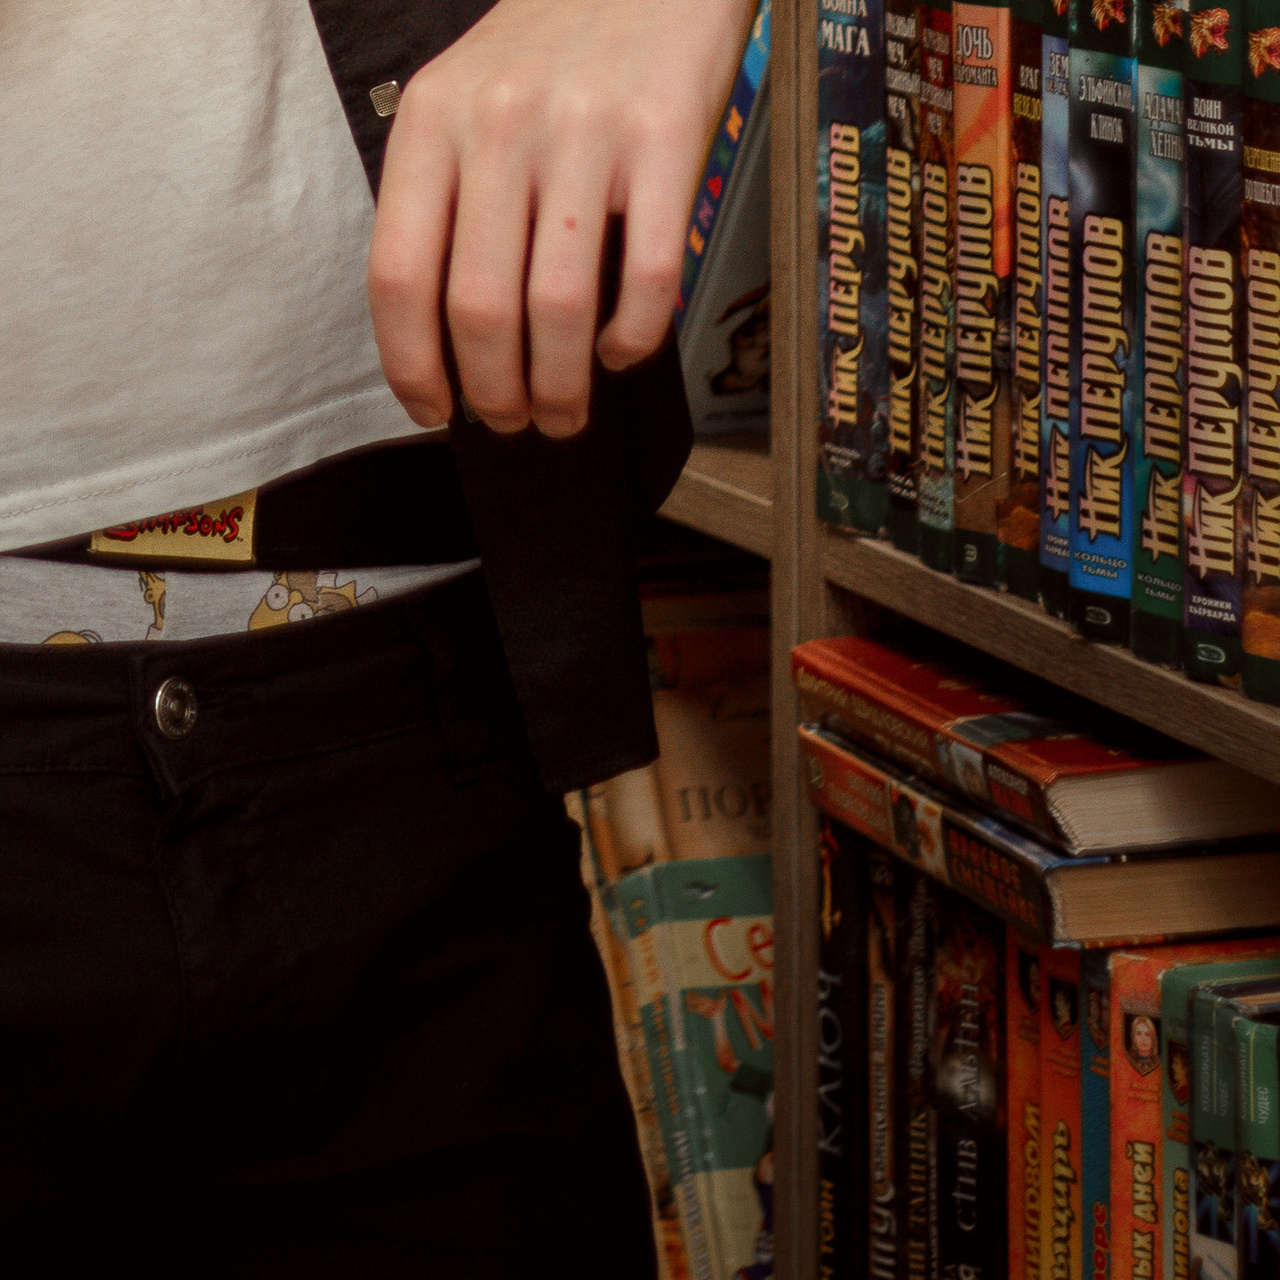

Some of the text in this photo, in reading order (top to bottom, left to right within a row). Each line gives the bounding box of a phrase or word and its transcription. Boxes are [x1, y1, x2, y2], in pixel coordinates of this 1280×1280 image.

[821, 19, 871, 57] МАГА
[1049, 52, 1069, 79] ЗЕМ
[1079, 75, 1132, 111] ЭЛЬФИЙСКИЙ
[1143, 92, 1183, 125] АДАМА
[1194, 97, 1221, 120] ВОИН
[1091, 113, 1123, 143] КЛИНОК
[1187, 118, 1234, 136] ВЕЛИКОЙ
[1188, 134, 1234, 151] ТЬМЫ
[829, 122, 865, 337] ПЕРУМОВ
[922, 162, 952, 382] ПЕРУМОВ
[1016, 162, 1042, 387] ПЕРУМОВ
[956, 162, 999, 481] НИК ПЕРУМОВ
[829, 336, 864, 429] НИК
[1079, 214, 1131, 543] НИК ПЕРУМОВ
[1248, 248, 1280, 482] ПЕРУМОВ
[1142, 231, 1183, 564] НИК ПЕРУМОВ
[1187, 245, 1243, 580] НИК ПЕРУМОВ
[1074, 551, 1127, 569] КОЛЬЦО
[1082, 565, 1117, 579] ТЬМЫ
[1136, 573, 1182, 592] КОЛЬЦО
[1145, 588, 1175, 602] ТЬМЫ
[1191, 595, 1232, 610] ХРОНИКИ
[949, 828, 1019, 890] КРАСНОЕ
[819, 970, 842, 1157] КЛЮЧ
[953, 984, 979, 1231] СТИВ АЛЬТЕН
[1257, 1086, 1269, 1124] ЧУДЕС
[1125, 1140, 1158, 1224] дней
